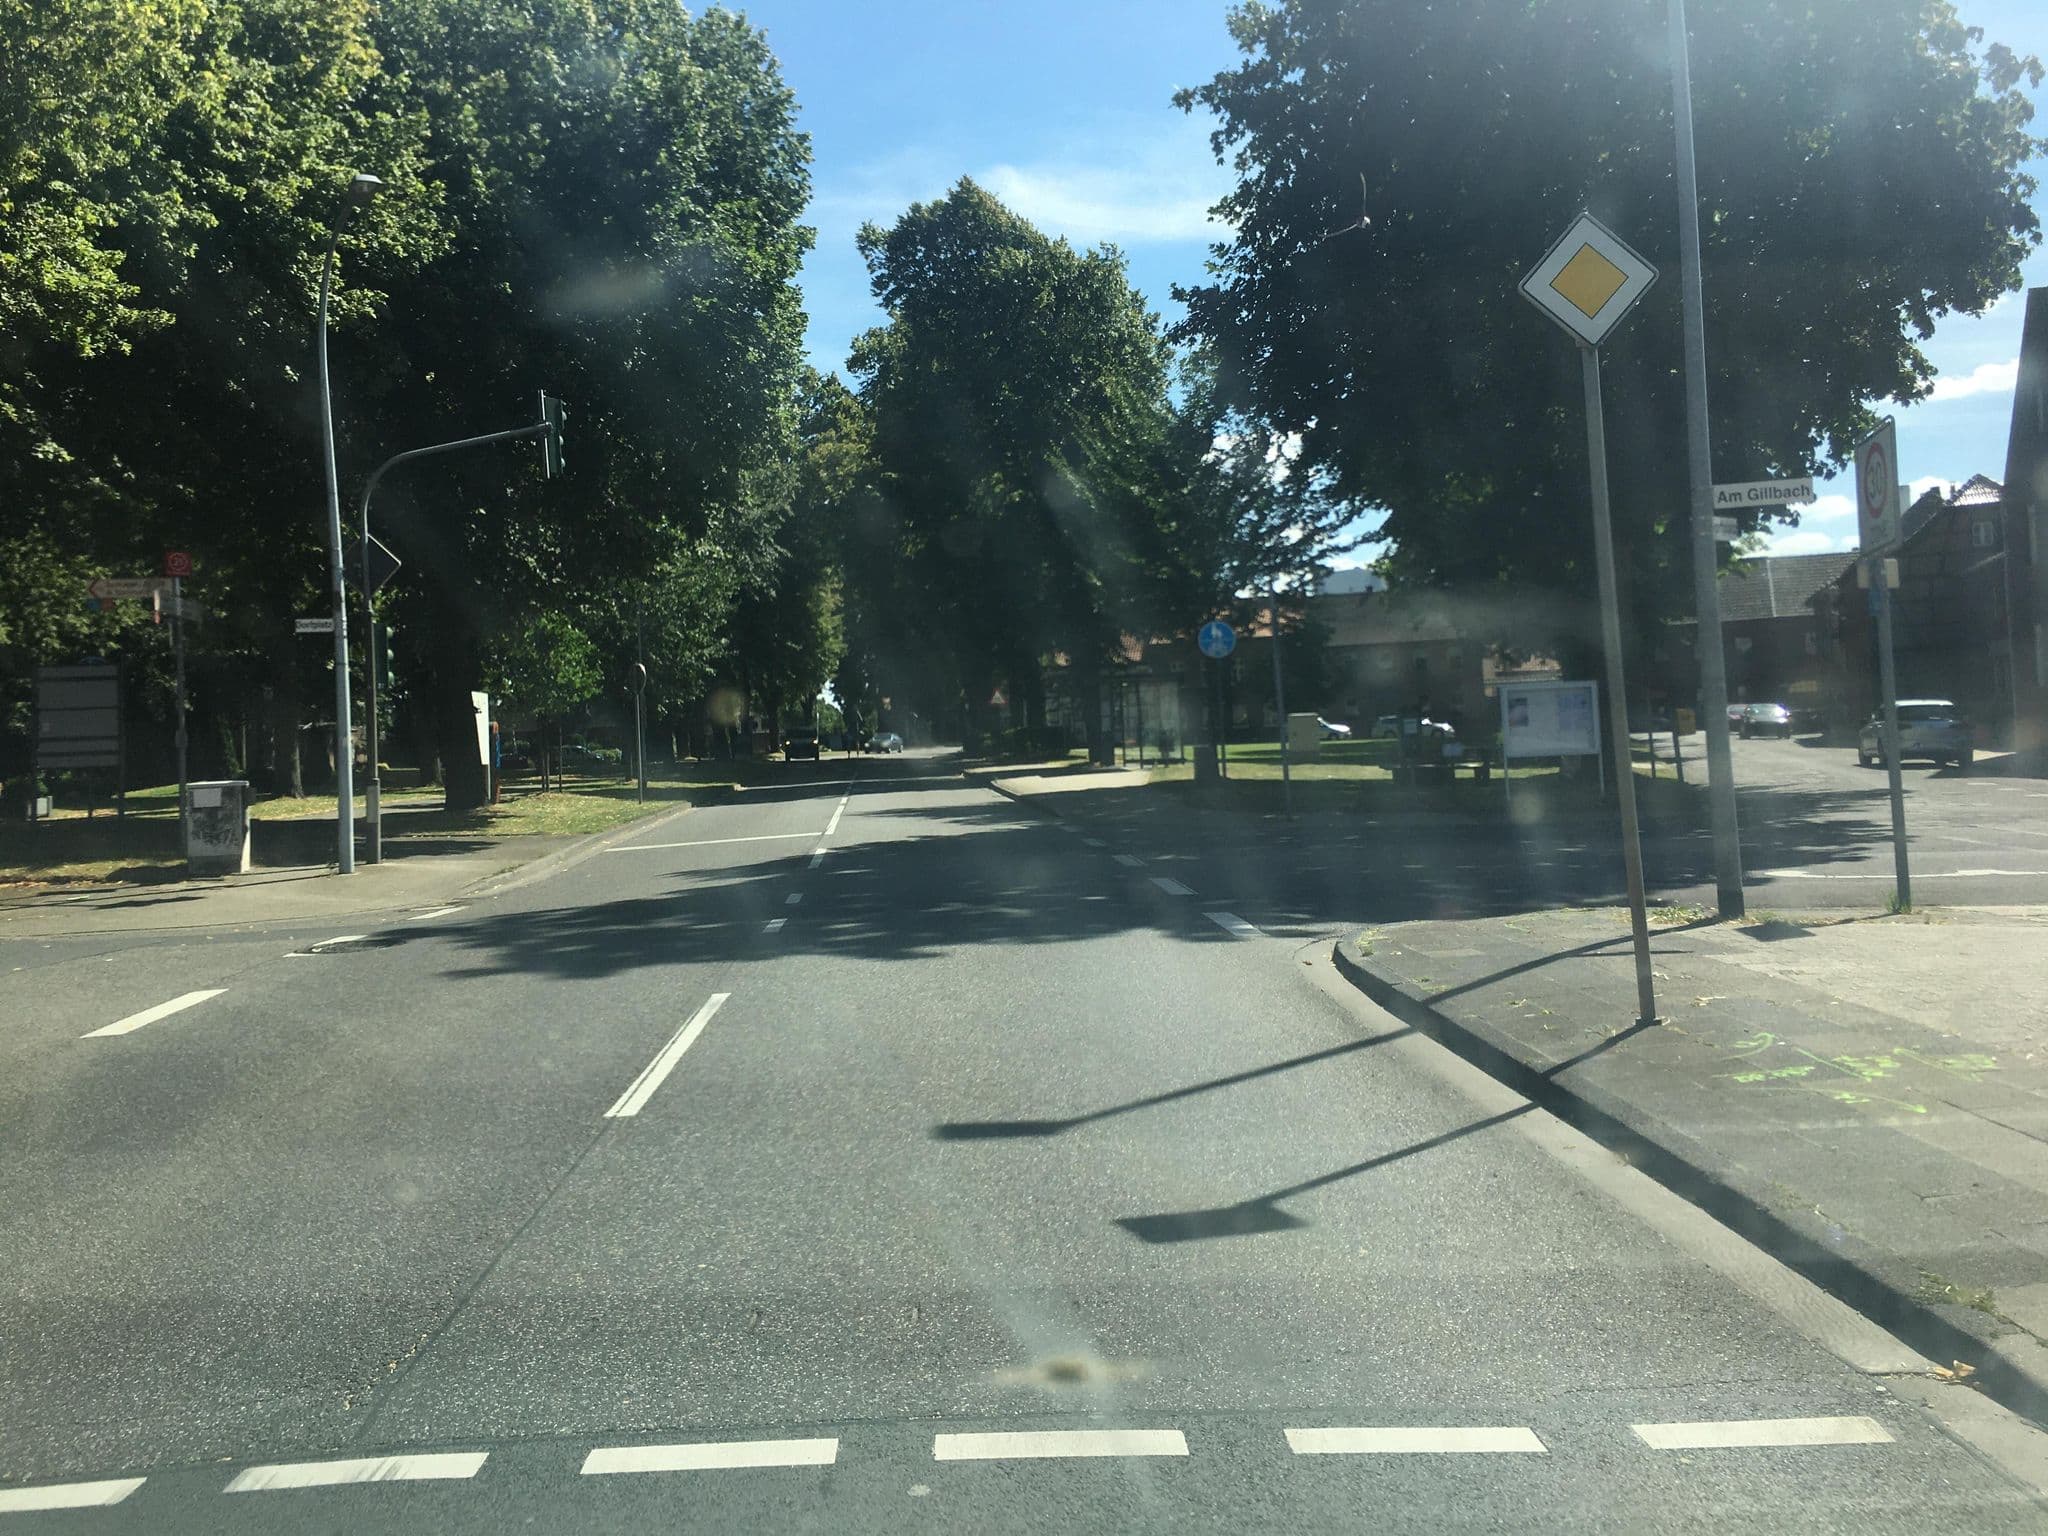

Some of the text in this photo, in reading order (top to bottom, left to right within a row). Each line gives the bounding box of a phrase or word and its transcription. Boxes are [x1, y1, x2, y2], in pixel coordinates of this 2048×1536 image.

[1868, 461, 1883, 498] 30
[1718, 484, 1811, 504] Am Gillbach
